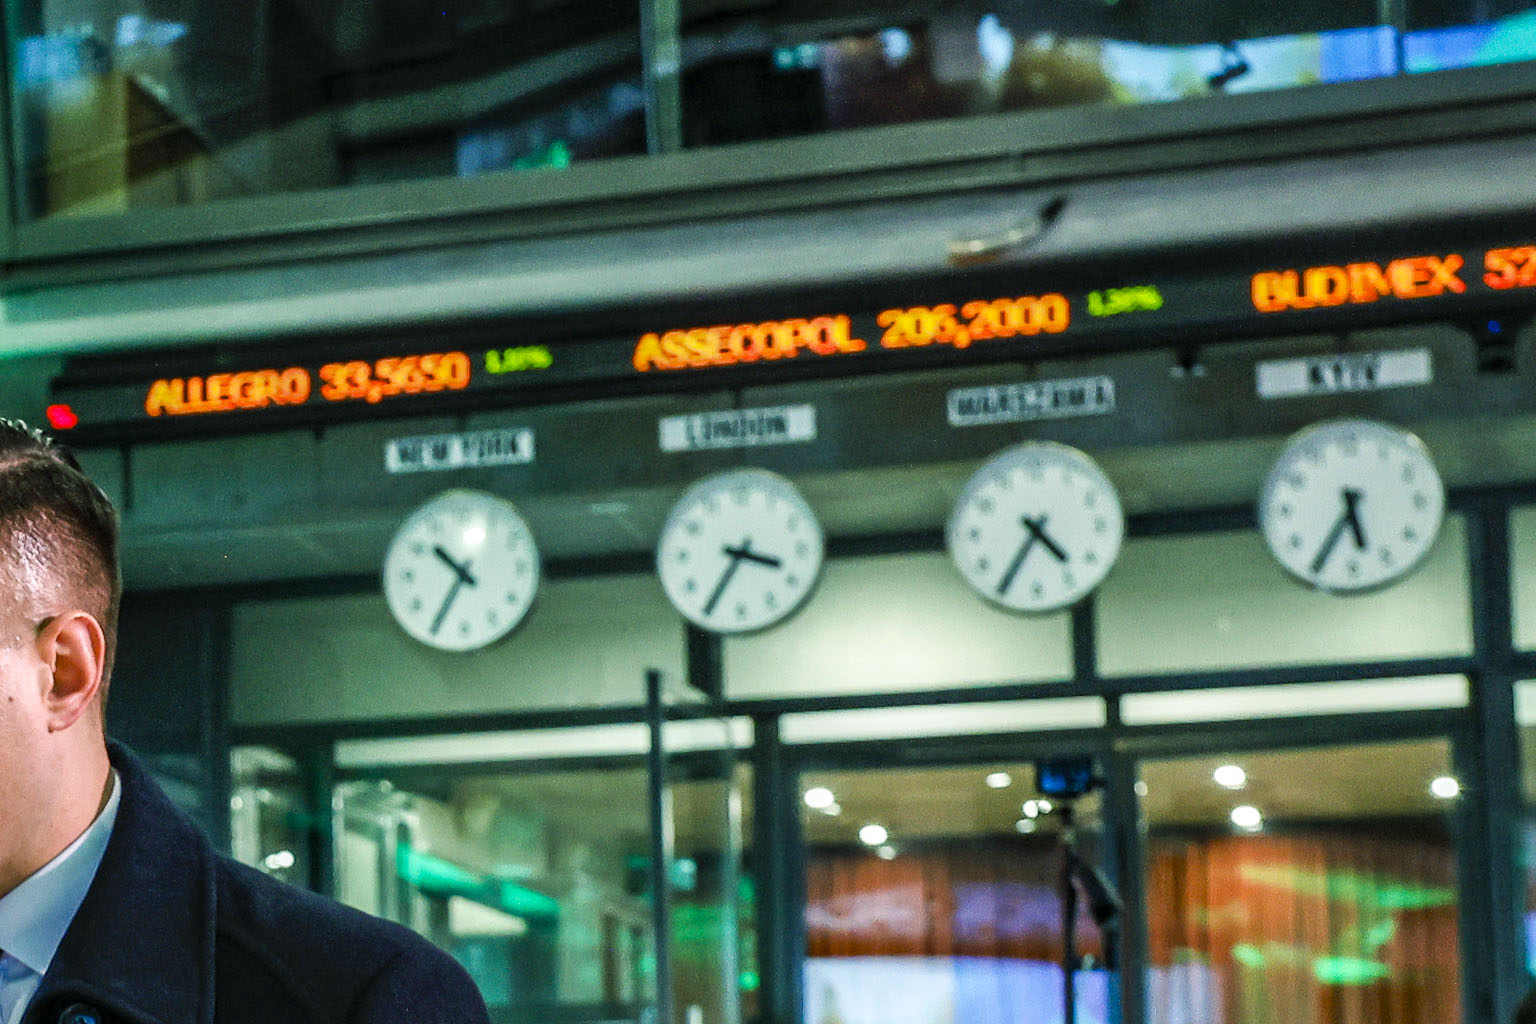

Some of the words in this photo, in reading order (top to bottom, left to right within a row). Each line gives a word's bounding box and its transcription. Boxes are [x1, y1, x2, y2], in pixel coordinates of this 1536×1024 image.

[146, 368, 312, 418] ALLEGRO
[320, 352, 472, 404] 33,5650
[634, 315, 868, 373] ASSECOPOL
[877, 294, 1071, 350] 206,2000
[1252, 255, 1468, 314] BUDIMEX
